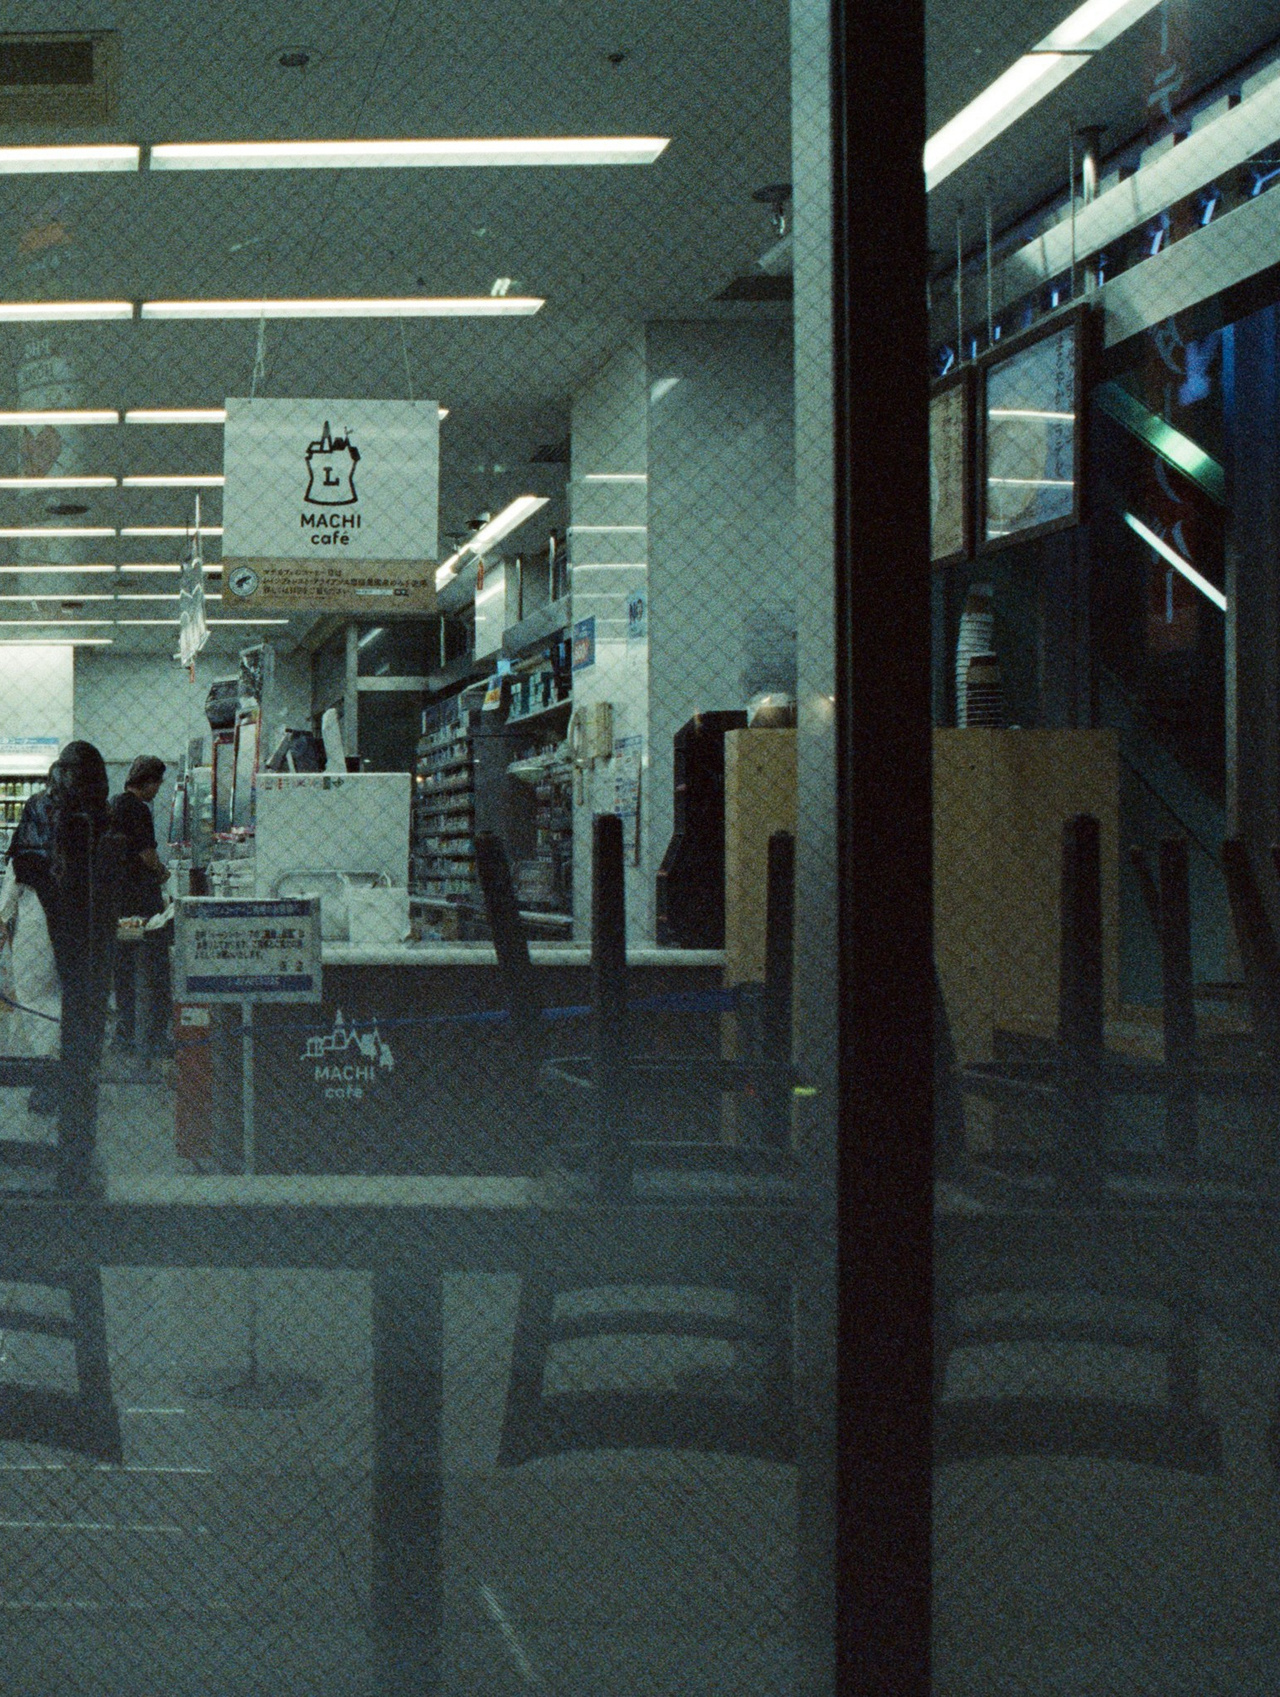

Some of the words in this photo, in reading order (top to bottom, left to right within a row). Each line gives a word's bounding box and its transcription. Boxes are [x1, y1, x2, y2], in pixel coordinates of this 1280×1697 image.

[300, 513, 361, 529] MACHI
[310, 530, 350, 545] café
[314, 1065, 375, 1082] MACHI
